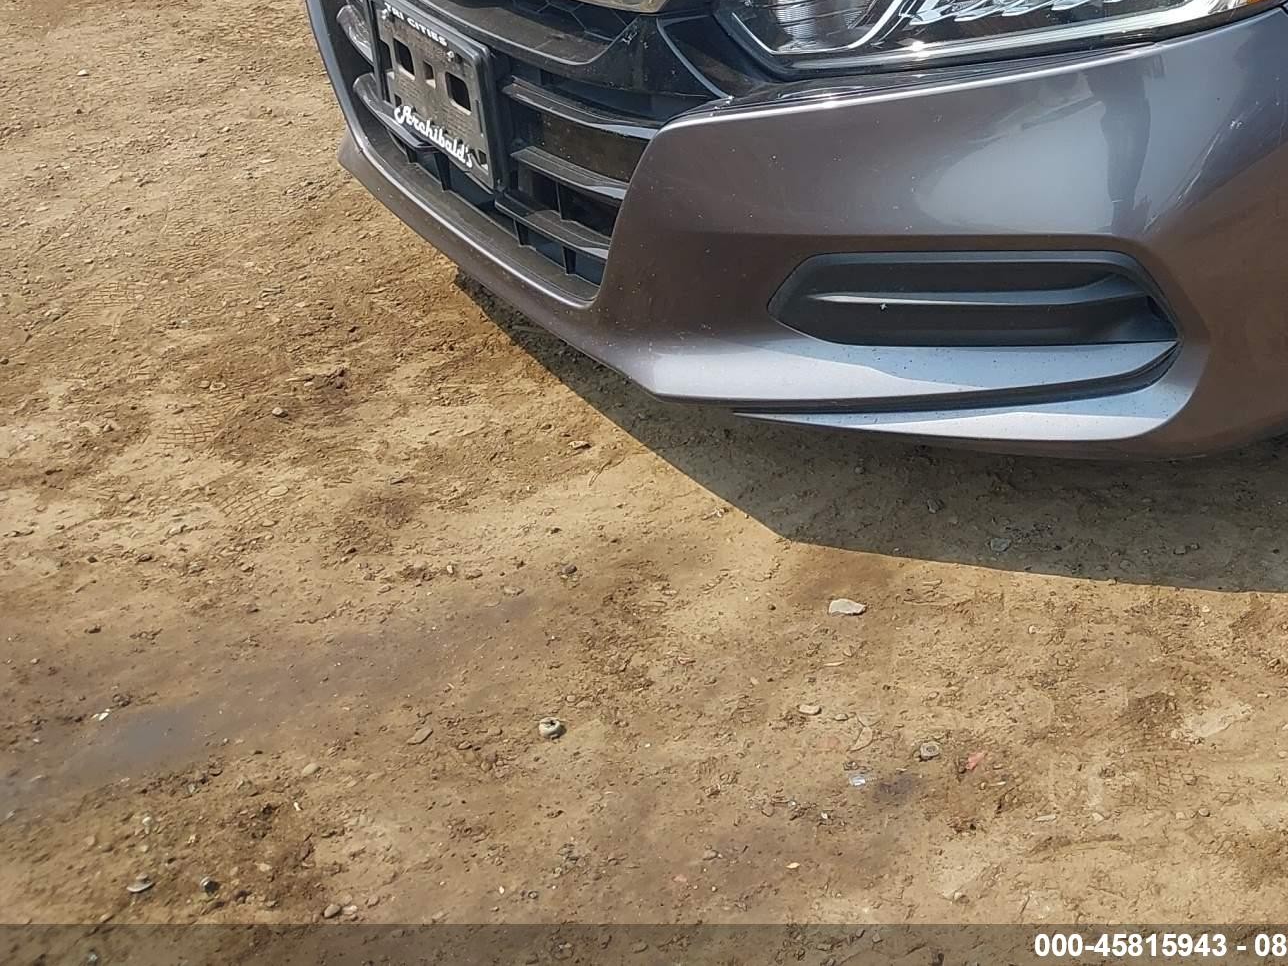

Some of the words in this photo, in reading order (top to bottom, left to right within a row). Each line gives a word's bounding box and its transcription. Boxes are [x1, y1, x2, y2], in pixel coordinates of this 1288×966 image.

[383, 1, 405, 21] TRI
[406, 17, 448, 47] CITIES
[393, 105, 473, 169] Archibald's
